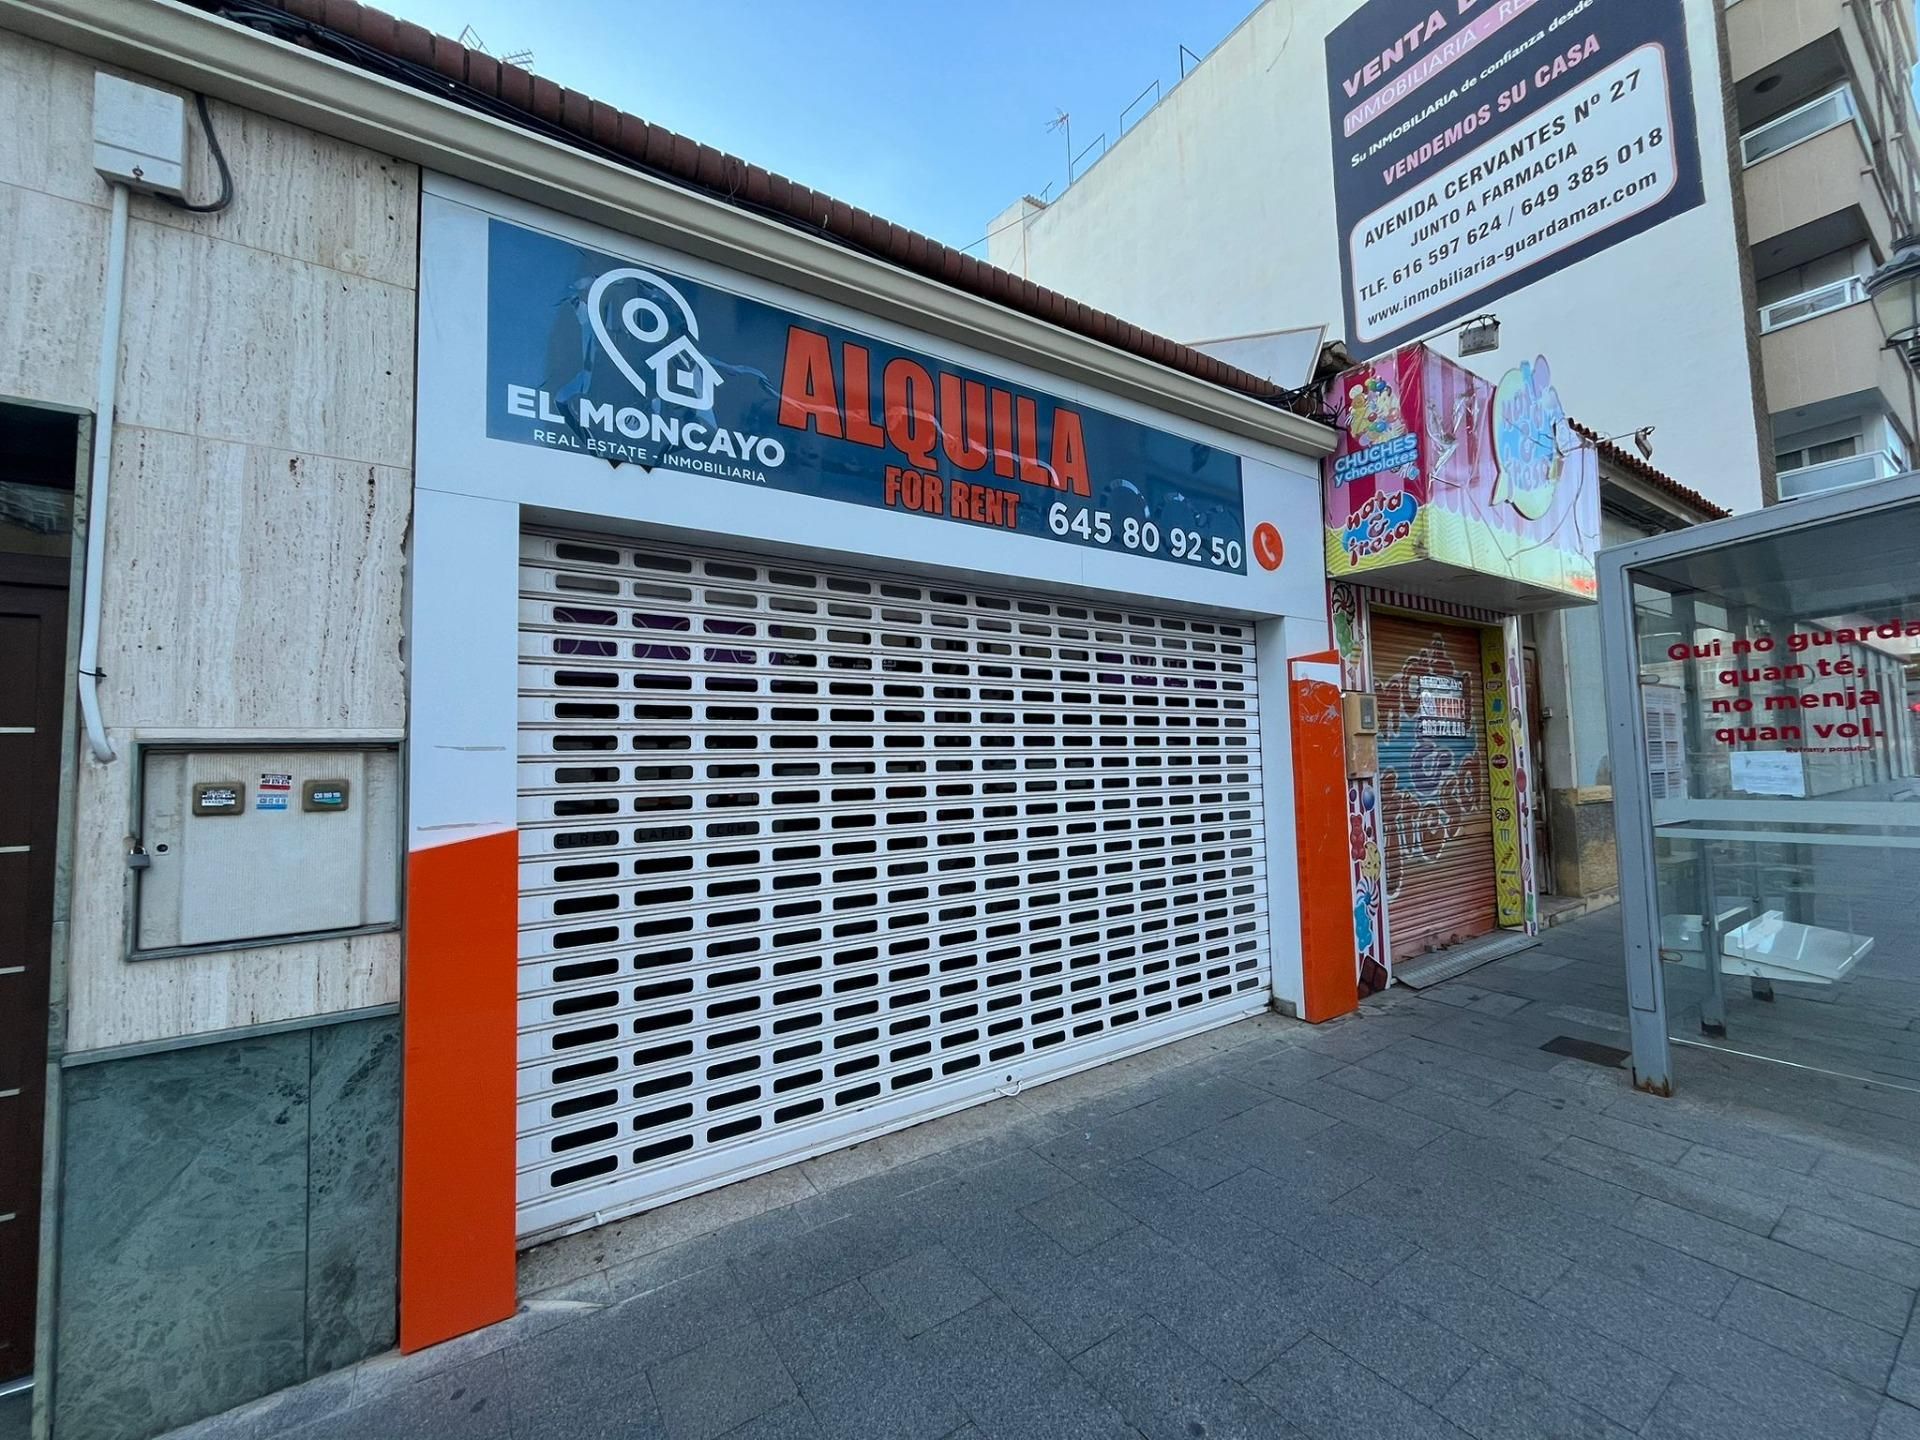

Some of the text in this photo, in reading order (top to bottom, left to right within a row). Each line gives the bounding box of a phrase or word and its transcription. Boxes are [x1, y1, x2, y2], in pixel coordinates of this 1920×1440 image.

[1342, 10, 1447, 98] VENTA
[1346, 30, 1477, 132] INMOBILIARIA
[1351, 0, 1594, 168] Su INMOBILIARIA de confianza desde
[1383, 33, 1600, 185] VENDEMOS SU CASA
[1365, 193, 1439, 248] AVENIDA
[1444, 115, 1566, 200] CERVANTES
[1609, 69, 1641, 103] 27
[1360, 277, 1388, 301] TLF.
[1393, 258, 1423, 285] 616
[1428, 237, 1461, 266] 597
[1467, 214, 1502, 246] 624
[1521, 183, 1559, 217] 649
[1567, 155, 1609, 192] 385
[1617, 127, 1663, 165] 018
[1411, 142, 1578, 247] JUNTO A FARMACIA
[1367, 172, 1657, 326] www.inmobiliaria-guardamar.com
[507, 383, 787, 468] EL MONCAYO
[777, 325, 1092, 498] ALQUILA
[534, 429, 580, 449] REAL
[587, 438, 648, 461] ESTATE
[663, 453, 767, 483] INMOBILIARIA
[1335, 432, 1418, 472] CHUCHES
[1345, 449, 1418, 481] chocolates
[884, 464, 1021, 530] FOR RENT
[1347, 490, 1403, 531] nata
[1047, 500, 1242, 569] 645 80 92 50
[1348, 521, 1410, 566] fresa
[1667, 638, 1722, 661] Qui
[1732, 634, 1775, 655] no
[1718, 654, 1868, 688] quan té,
[1712, 686, 1881, 714] no menja
[1715, 717, 1884, 746] quan vol.
